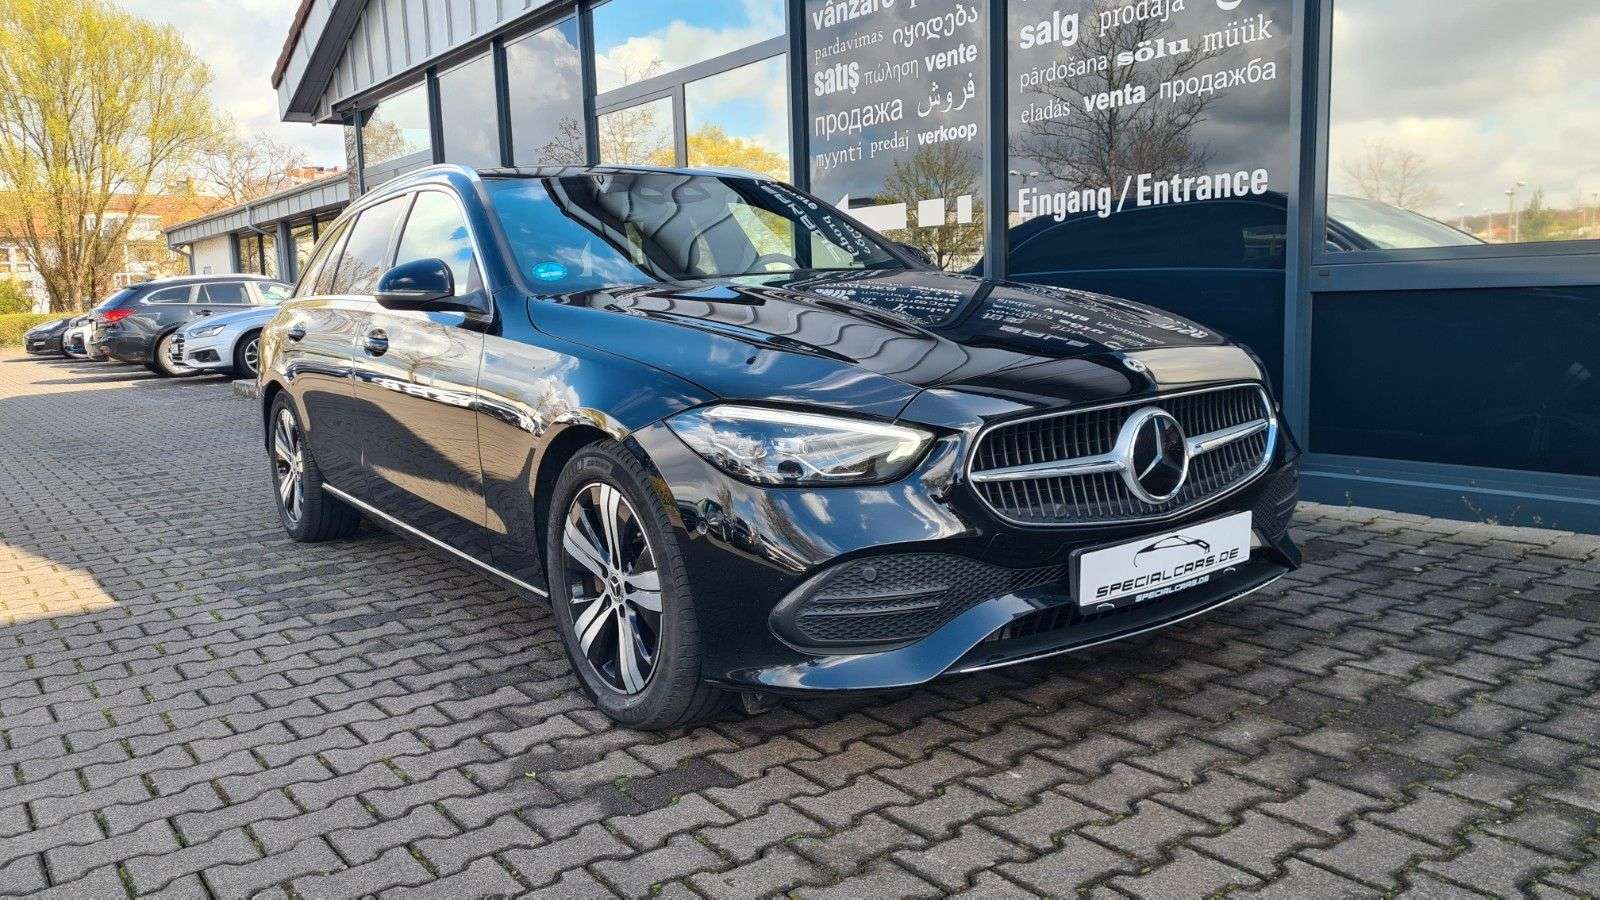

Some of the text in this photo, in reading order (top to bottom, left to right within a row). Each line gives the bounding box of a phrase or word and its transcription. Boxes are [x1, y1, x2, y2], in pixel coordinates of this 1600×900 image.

[893, 4, 978, 47] იყიდება
[1020, 0, 1185, 50] salg prodaja
[814, 30, 884, 65] pardavimas
[925, 43, 978, 72] vente
[1020, 13, 1273, 94] pārdošana sölu müük
[814, 61, 860, 96] satış
[864, 59, 919, 86] πώληση
[1159, 57, 1277, 103] продажба
[917, 72, 976, 118] فروش
[1021, 83, 1147, 123] eladás venta
[815, 98, 903, 141] продажа
[816, 122, 978, 170] myynti predaj verkoop
[1018, 186, 1111, 222] Eingang
[1137, 168, 1268, 207] Entrance
[1096, 547, 1239, 599] SPECIALCARS.DE
